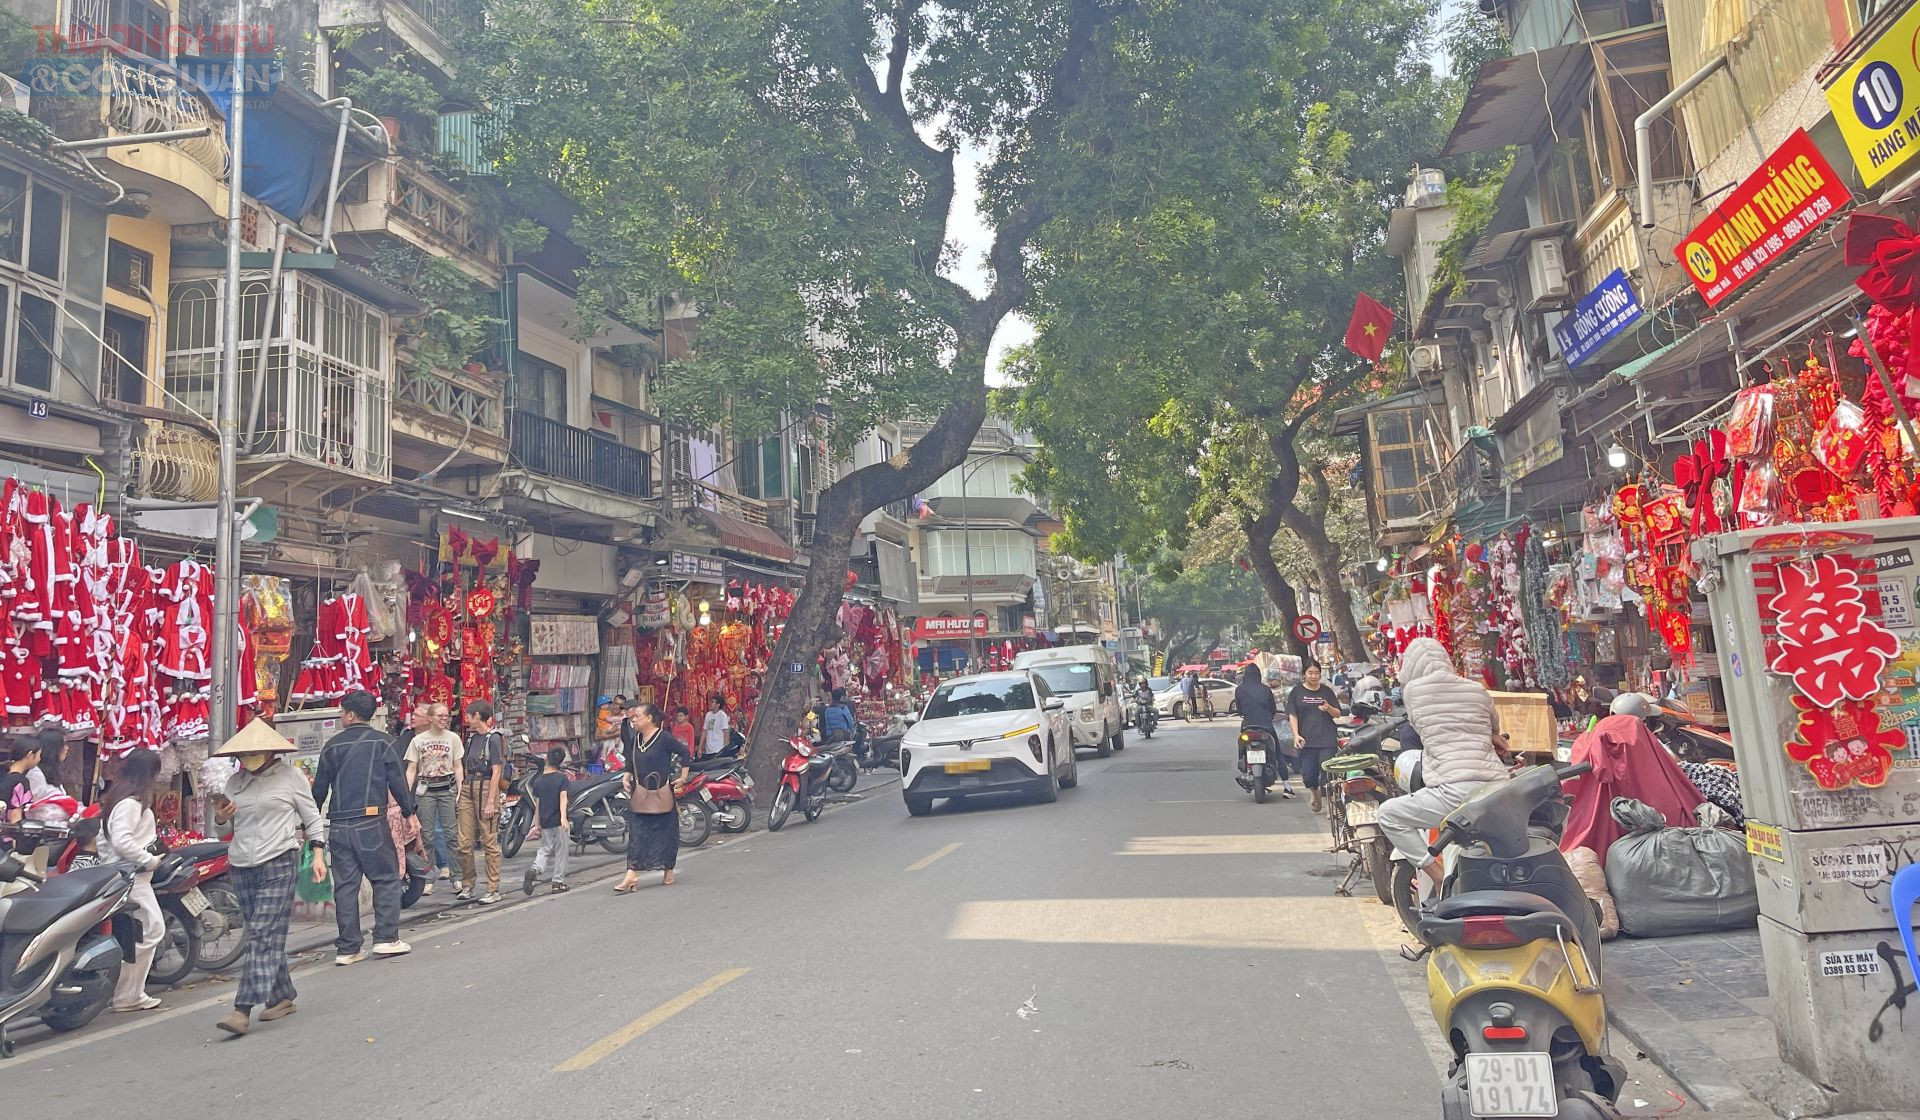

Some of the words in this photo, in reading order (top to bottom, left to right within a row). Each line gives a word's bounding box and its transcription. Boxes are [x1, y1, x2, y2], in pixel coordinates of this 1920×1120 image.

[1858, 67, 1897, 124] 10
[1868, 129, 1906, 169] HÀNG
[1707, 203, 1767, 265] THANH
[1753, 155, 1825, 225] THẮNG
[1782, 217, 1804, 240] 0984
[1798, 206, 1818, 227] 780
[1812, 195, 1832, 216] 269
[1690, 247, 1712, 278] 12A
[1557, 328, 1573, 352] 14
[1573, 308, 1599, 341] HỒNG
[1594, 284, 1629, 322] CƯỜNG
[32, 401, 46, 416] 13
[1892, 595, 1900, 604] 5
[925, 619, 946, 629] MAI
[793, 664, 802, 672] 19
[1839, 854, 1853, 865] XE
[1856, 852, 1880, 864] MÁY
[1824, 966, 1843, 975] 0389
[1845, 965, 1855, 974] 83
[1857, 964, 1867, 973] 83
[1869, 963, 1879, 972] 91
[1825, 953, 1842, 965] SỬA
[1843, 954, 1854, 963] XE
[1856, 952, 1873, 963] MÁY
[1478, 1058, 1539, 1082] 29-D1
[1475, 1085, 1550, 1113] 191.74
